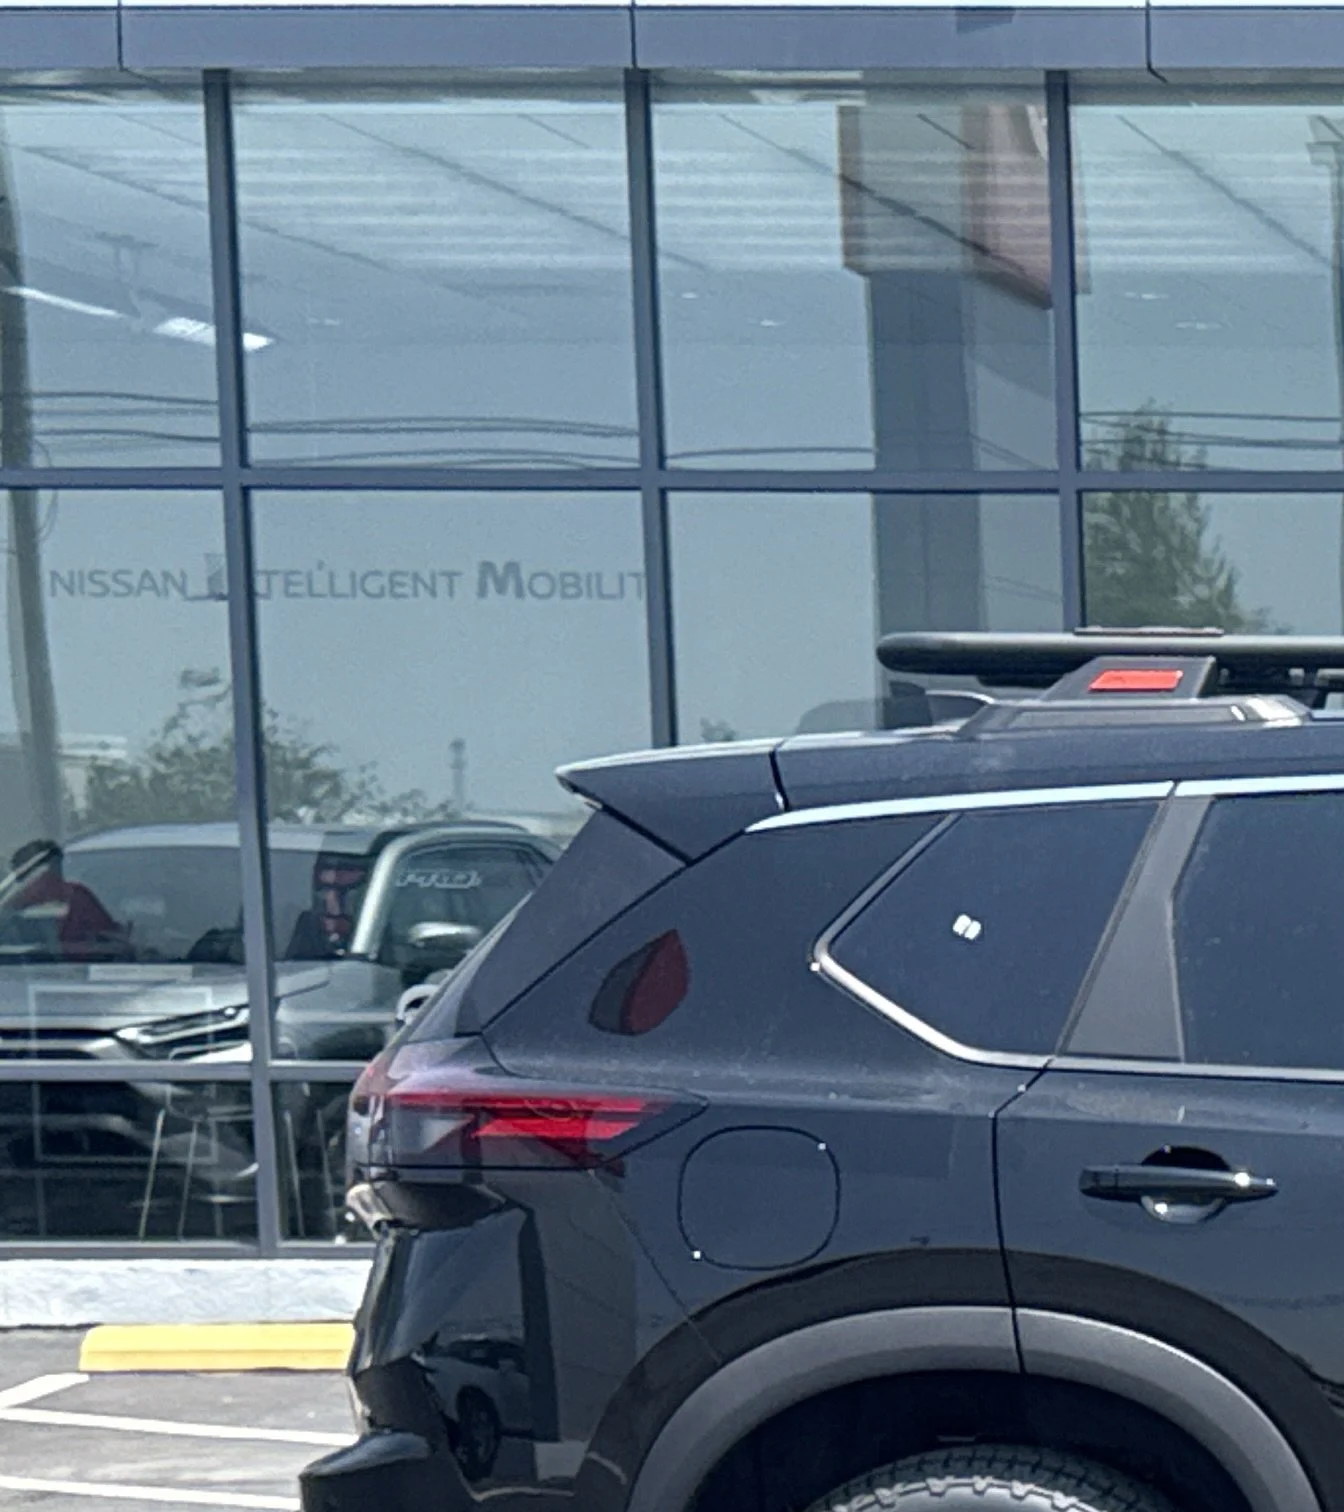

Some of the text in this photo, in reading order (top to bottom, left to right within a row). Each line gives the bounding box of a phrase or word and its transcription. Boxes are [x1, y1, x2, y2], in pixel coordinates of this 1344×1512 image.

[49, 556, 648, 600] NISSAN ITELLIGENT MOBILIT
